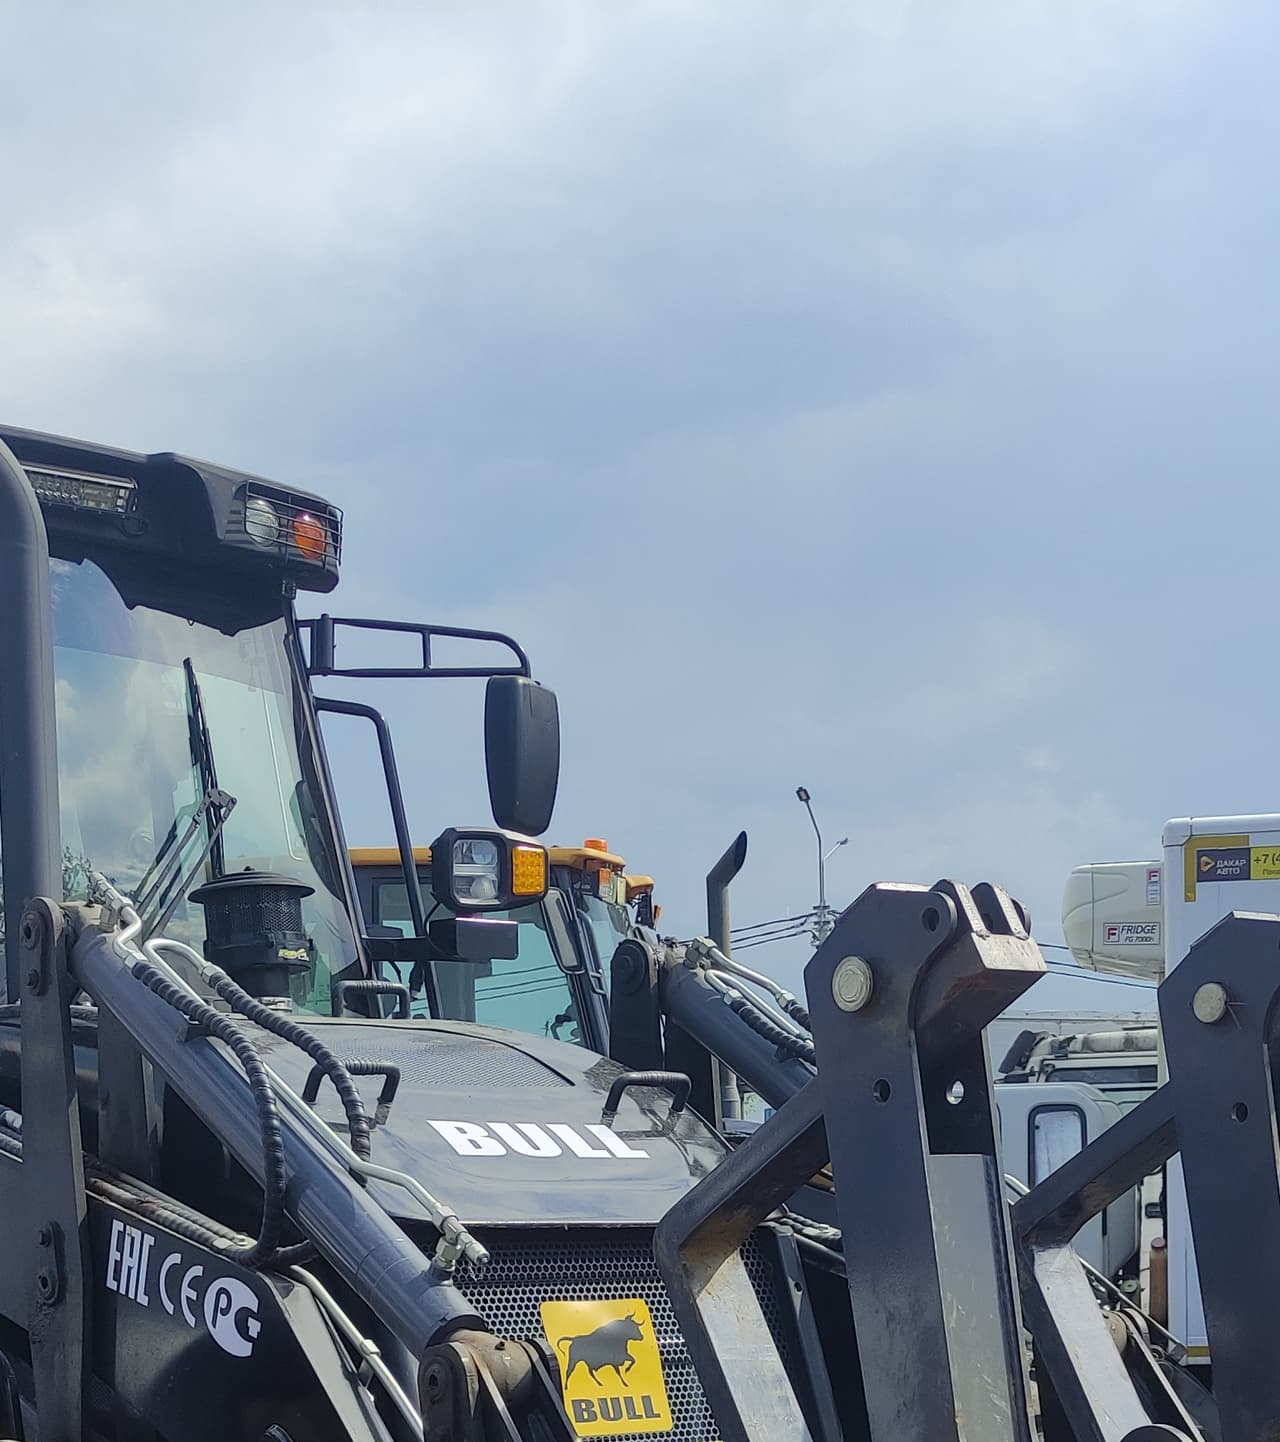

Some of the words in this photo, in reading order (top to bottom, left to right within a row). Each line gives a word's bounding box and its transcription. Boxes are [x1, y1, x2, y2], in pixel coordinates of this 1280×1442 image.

[1215, 858, 1247, 868] ДАКАР
[1253, 854, 1269, 865] +7
[1215, 867, 1240, 875] АВТО
[1120, 924, 1158, 935] FRIDGE
[426, 1119, 651, 1160] BULL
[571, 1394, 662, 1425] BULL
